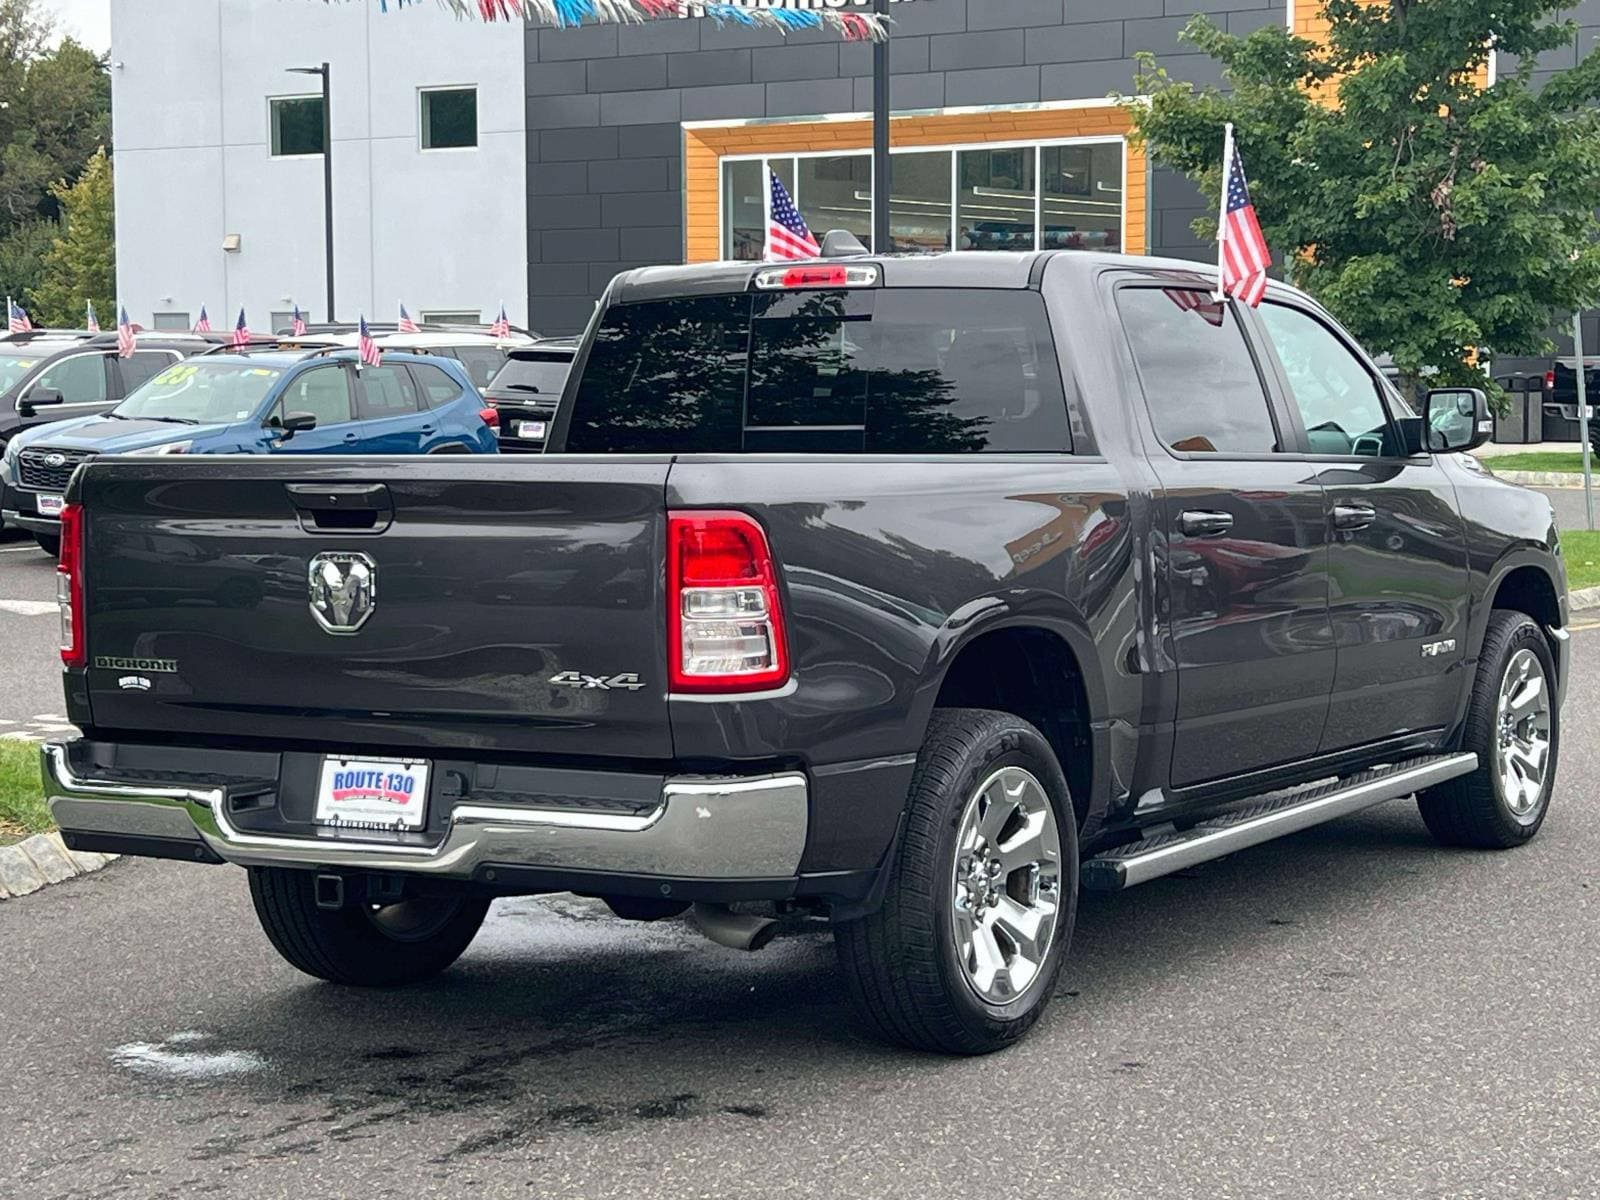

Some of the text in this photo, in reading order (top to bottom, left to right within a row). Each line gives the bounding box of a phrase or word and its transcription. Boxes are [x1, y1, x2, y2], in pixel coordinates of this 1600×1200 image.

[1421, 639, 1456, 657] RAM
[334, 771, 414, 794] ROUTE 130
